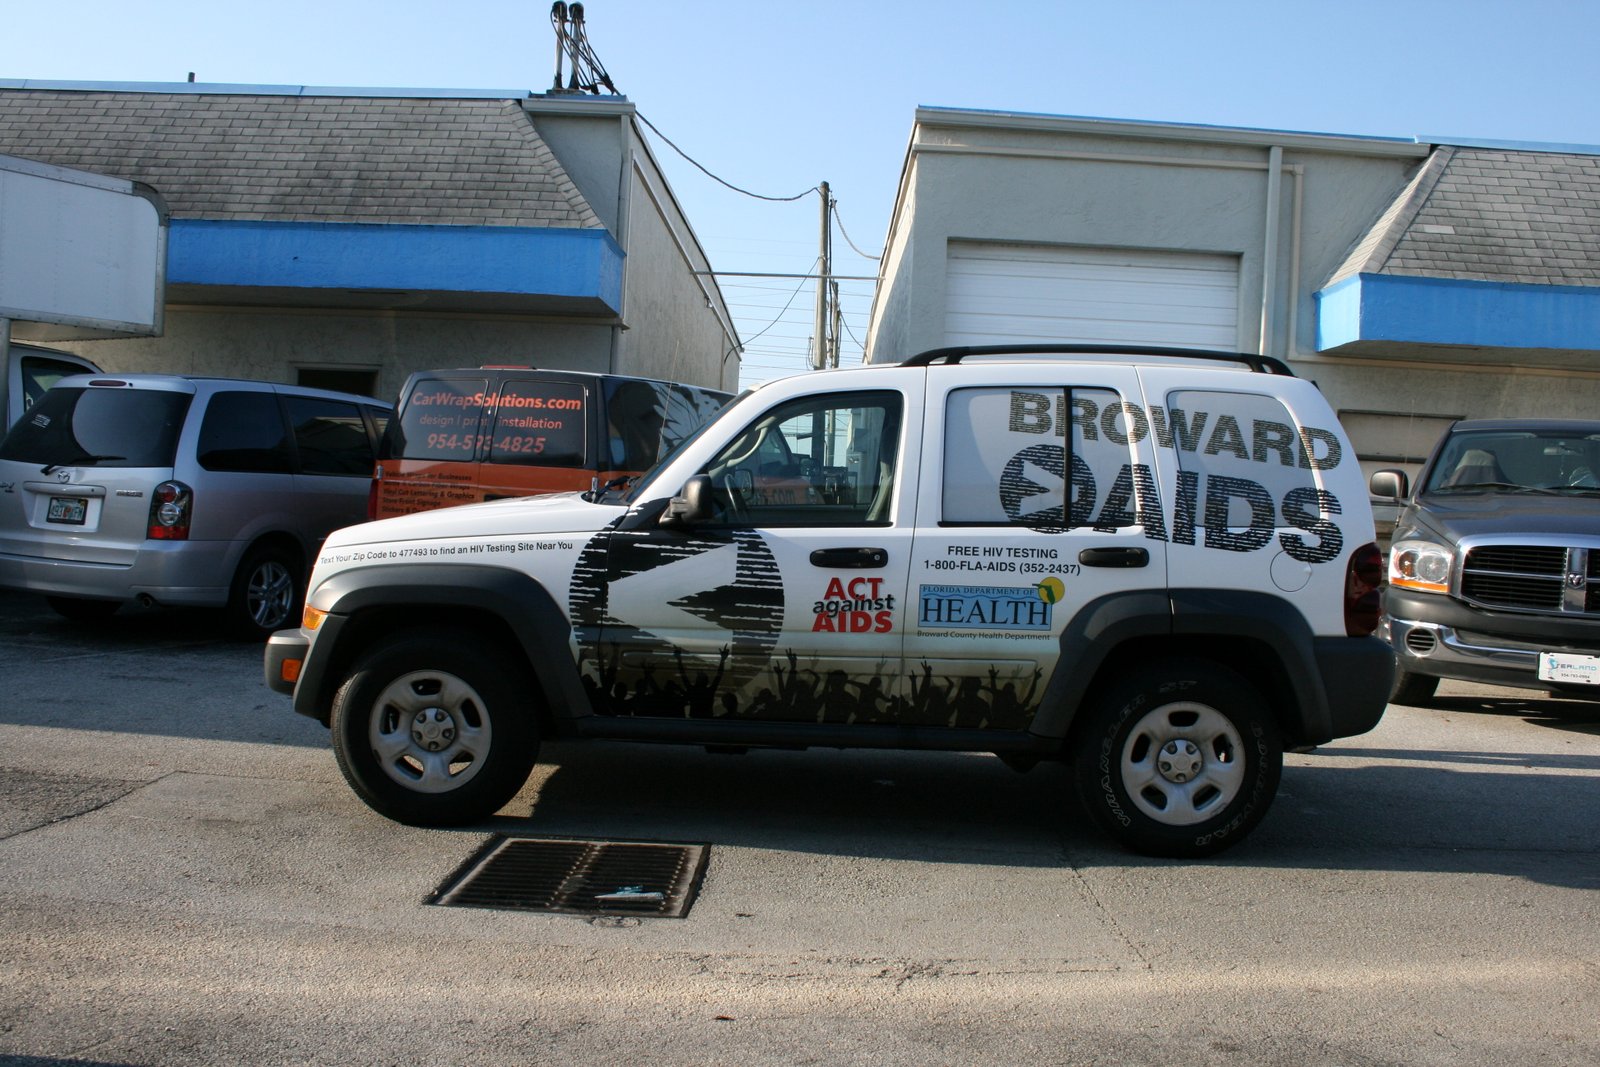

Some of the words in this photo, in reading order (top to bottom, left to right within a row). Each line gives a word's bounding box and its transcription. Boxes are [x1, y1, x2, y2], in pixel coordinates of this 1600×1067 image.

[412, 392, 582, 411] CarWrapSolutions.com
[419, 414, 454, 426] design
[498, 416, 563, 429] installation
[1009, 390, 1342, 471] BROWARD
[1092, 463, 1344, 564] AIDS
[321, 556, 334, 564] Text
[335, 554, 351, 563] Your
[353, 552, 365, 562] Zip
[367, 551, 388, 560] Code
[389, 550, 397, 558] to
[399, 547, 428, 557] 477493
[430, 547, 438, 555] to
[440, 547, 455, 555] find
[470, 545, 484, 553] HIV
[486, 544, 516, 554] Testing
[517, 542, 534, 551] Site
[536, 542, 556, 550] Near
[558, 541, 573, 550] You
[948, 545, 980, 557] FREE
[983, 547, 1004, 557] HIV
[1006, 547, 1058, 559] TESTING
[924, 559, 1016, 572] 1-800-FLA-AIDS
[1019, 562, 1081, 576] (352-2437)
[823, 577, 884, 601] ACT
[922, 585, 961, 594] FLORIDA
[963, 586, 1021, 596] DEPARTMENT
[812, 593, 895, 618] against
[921, 598, 1049, 626] HEALTH
[811, 610, 893, 633] AIDS
[917, 630, 948, 638] Broward
[949, 630, 977, 640] County
[978, 631, 1003, 640] Health
[1004, 632, 1050, 641] Department
